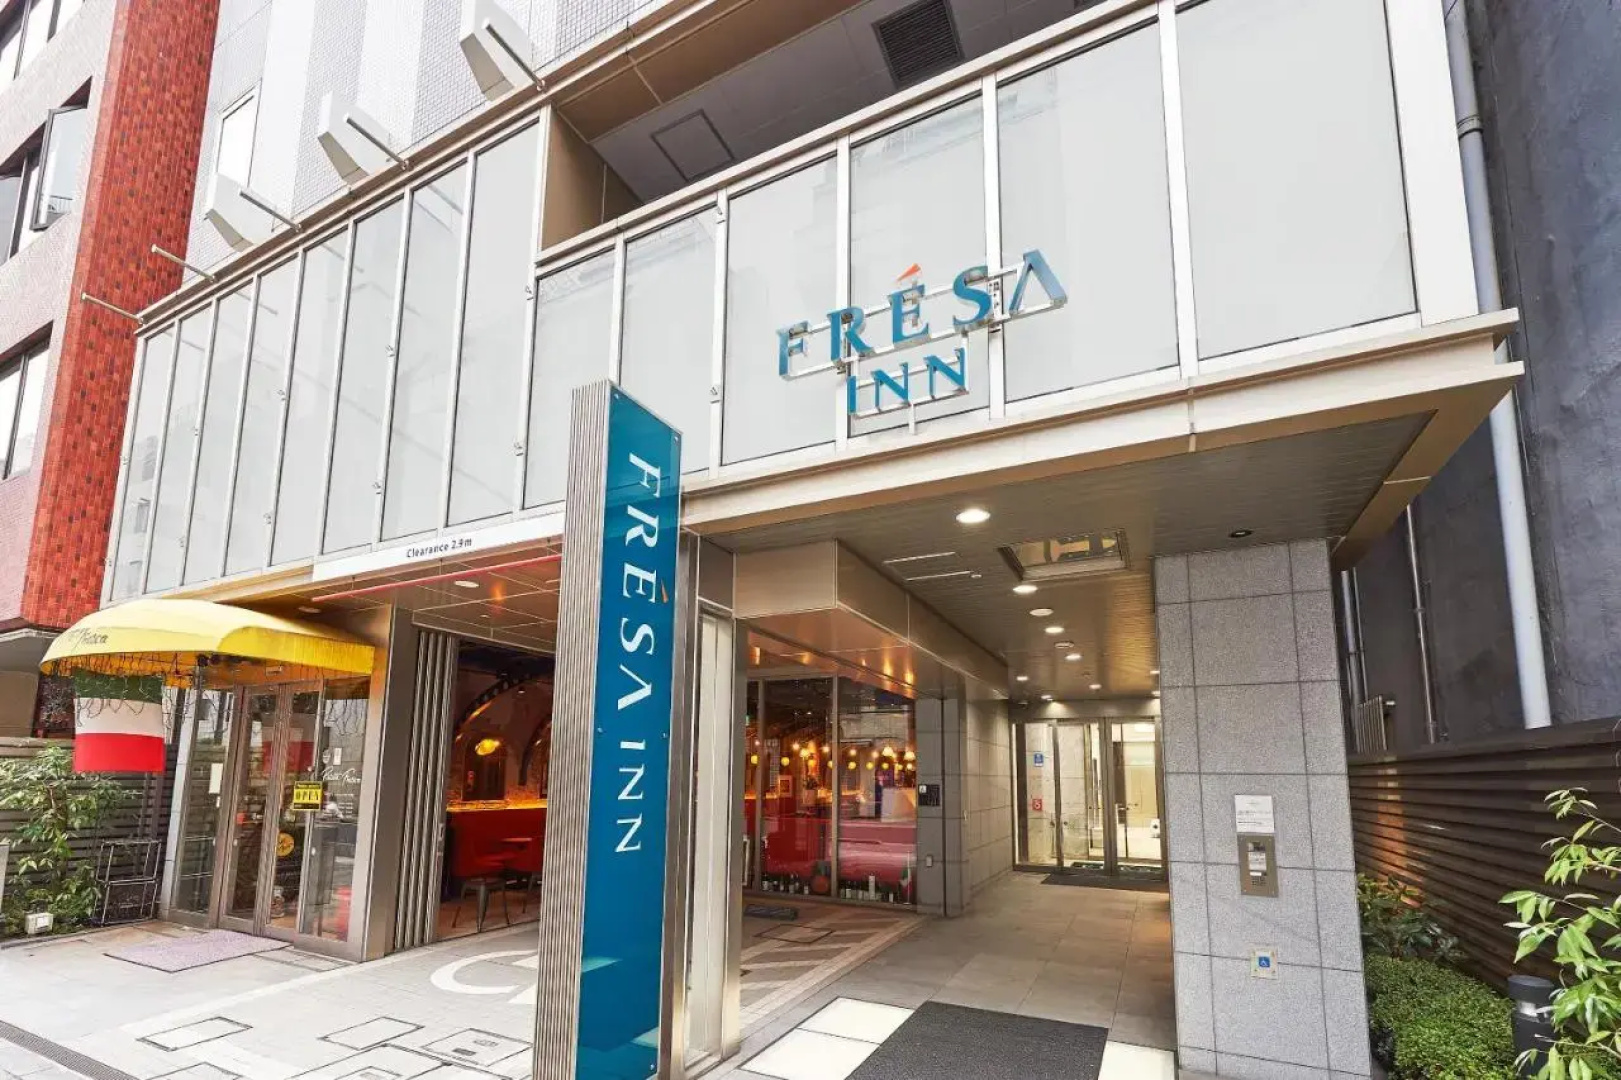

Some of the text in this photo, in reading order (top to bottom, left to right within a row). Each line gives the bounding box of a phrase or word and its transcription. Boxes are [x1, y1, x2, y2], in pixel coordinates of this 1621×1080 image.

[777, 249, 1068, 379] FRÉSA
[847, 347, 969, 416] INN
[406, 543, 449, 558] Clearance
[615, 452, 669, 853] FRÉSA INN
